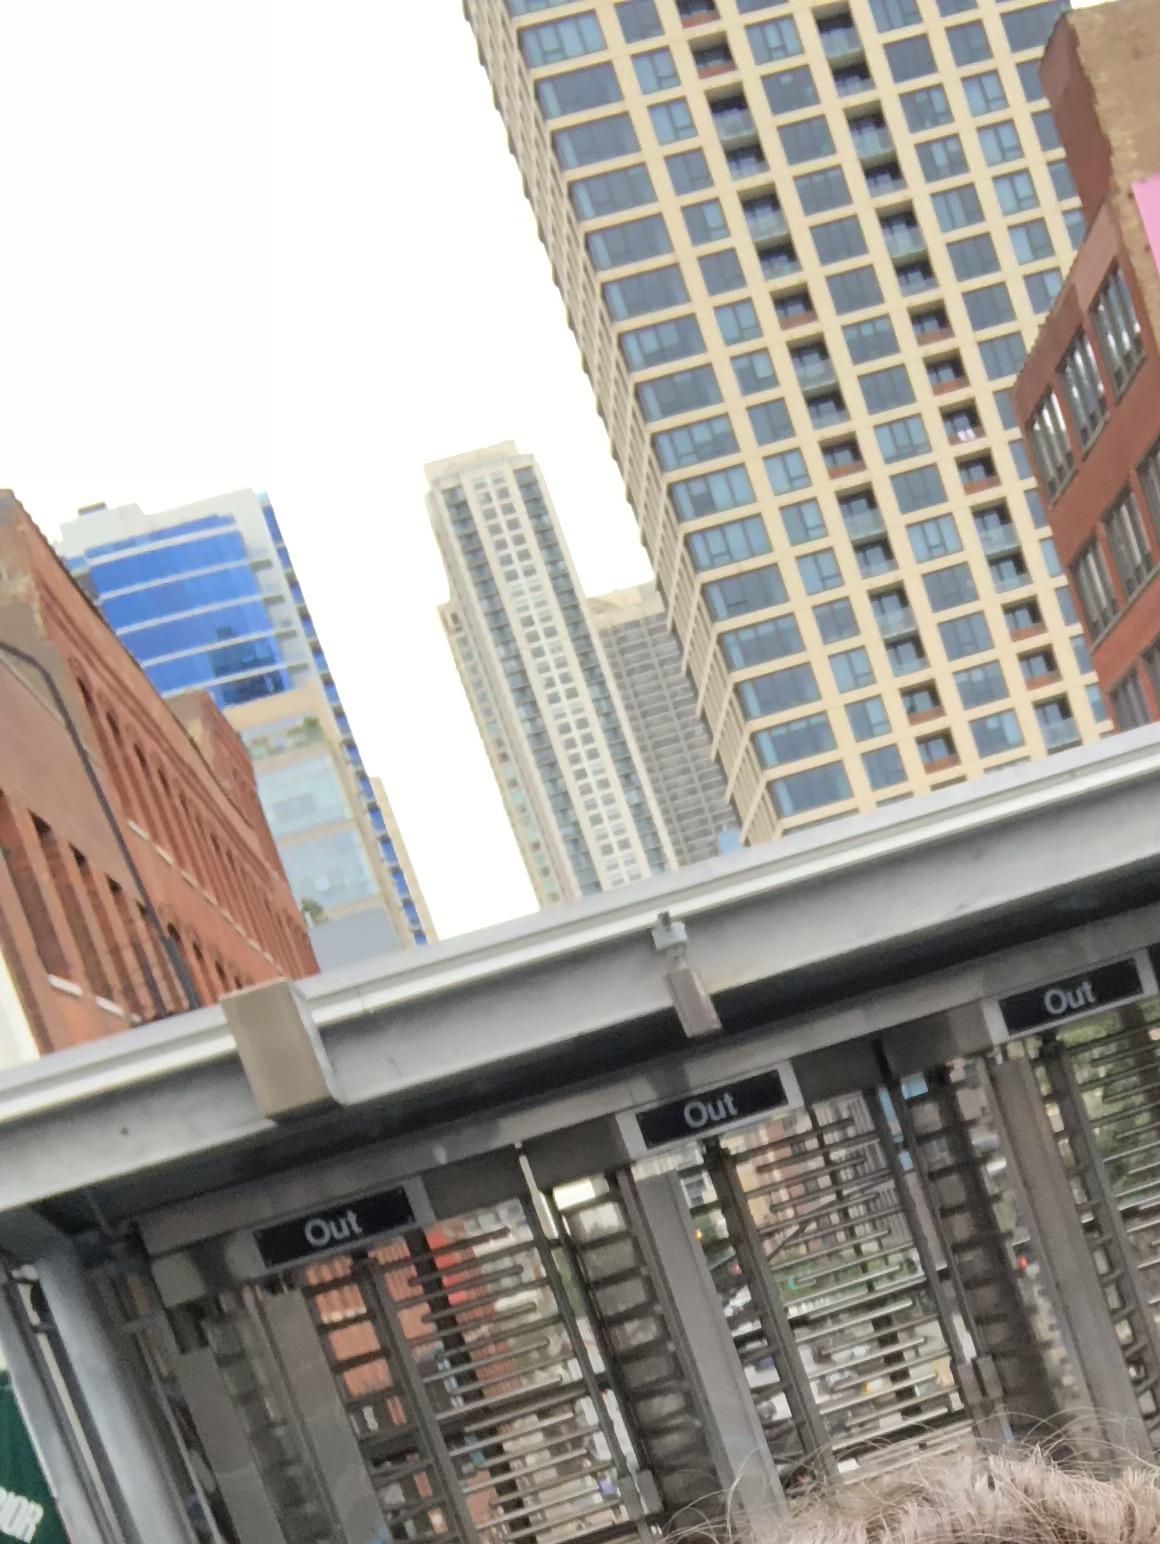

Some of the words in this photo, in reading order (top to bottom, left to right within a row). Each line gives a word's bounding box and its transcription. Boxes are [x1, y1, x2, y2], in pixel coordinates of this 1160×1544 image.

[1044, 982, 1095, 1015] Out
[683, 1092, 738, 1128] Out
[304, 1210, 363, 1247] Out
